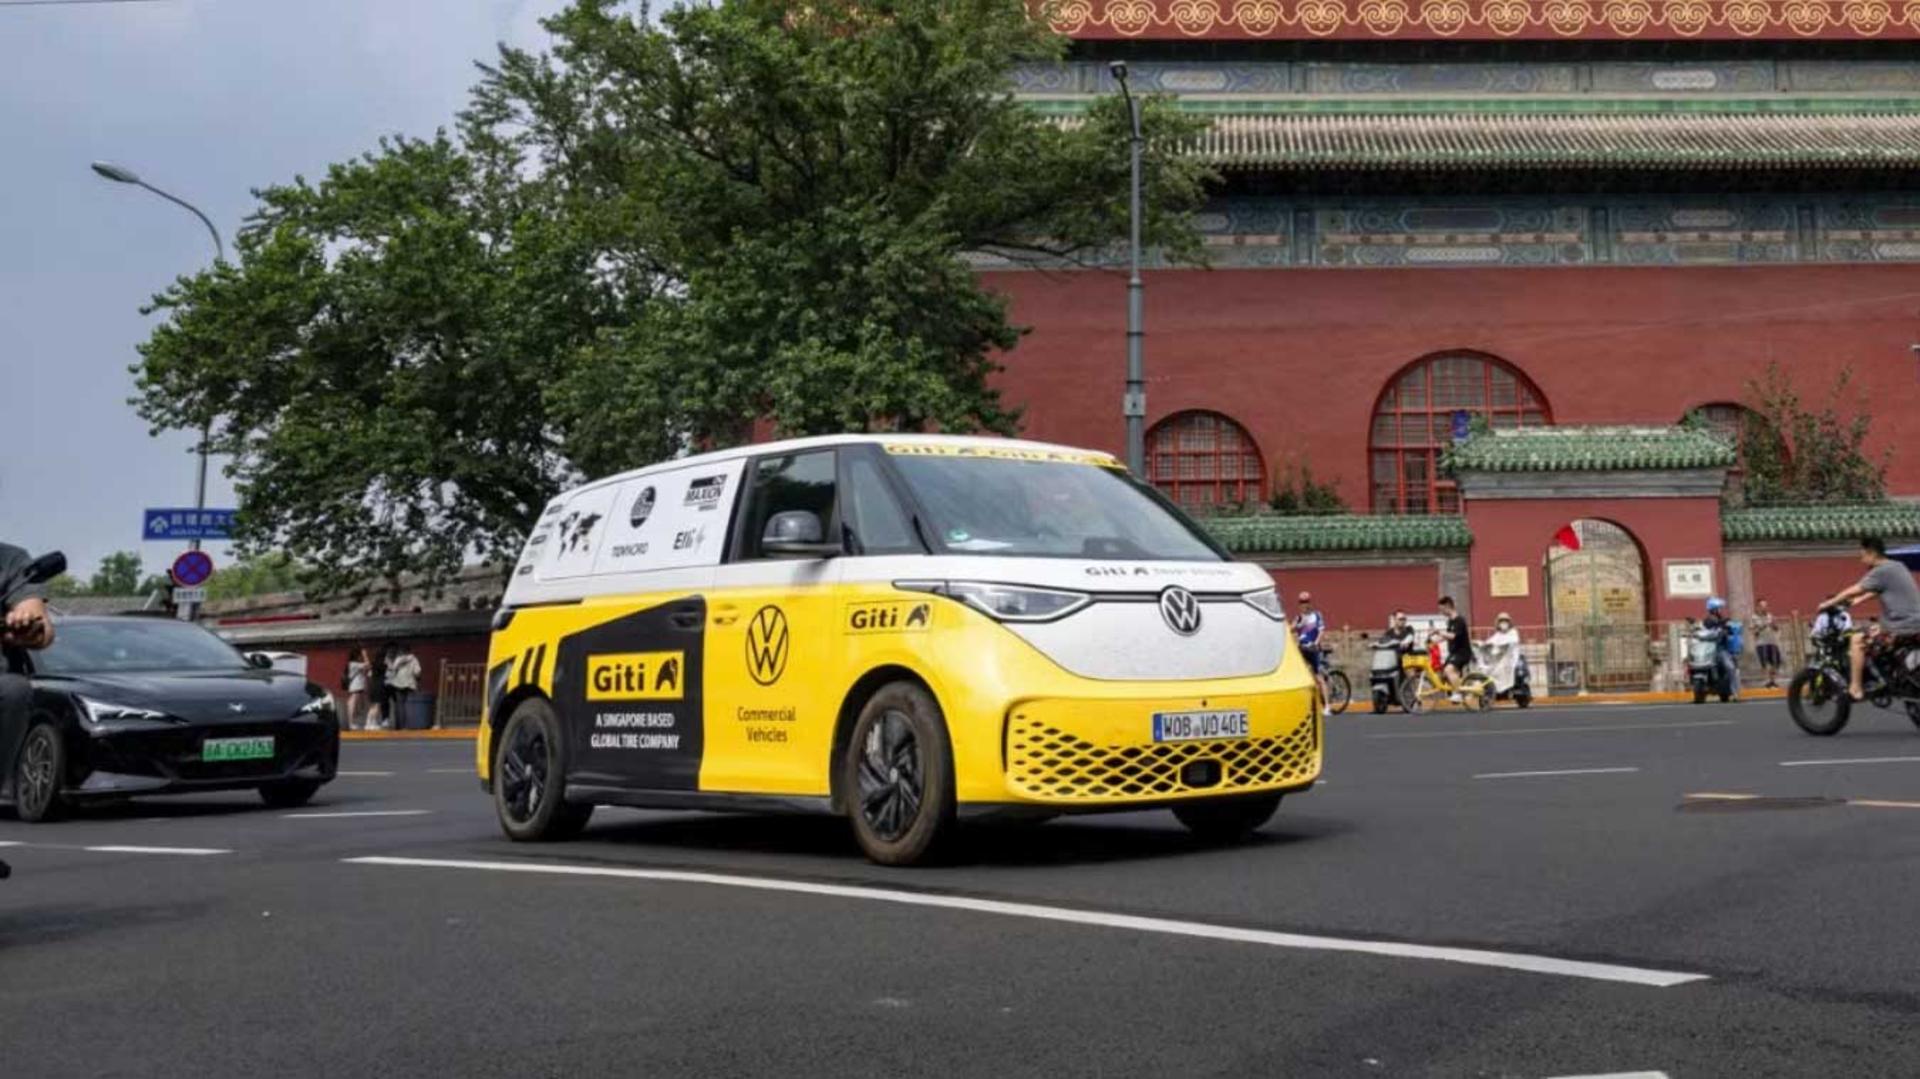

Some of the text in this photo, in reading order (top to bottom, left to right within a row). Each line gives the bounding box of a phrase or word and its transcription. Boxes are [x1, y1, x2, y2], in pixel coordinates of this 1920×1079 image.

[1085, 567, 1127, 576] Giti
[850, 607, 898, 629] Giti
[593, 663, 645, 692] Giti
[596, 713, 675, 727] A SINGAPORE BASED
[737, 706, 796, 721] Commercial
[1163, 716, 1191, 737] WOB
[591, 733, 680, 748] GLOBAL TIRE COMPANY
[746, 727, 788, 742] Vehicles
